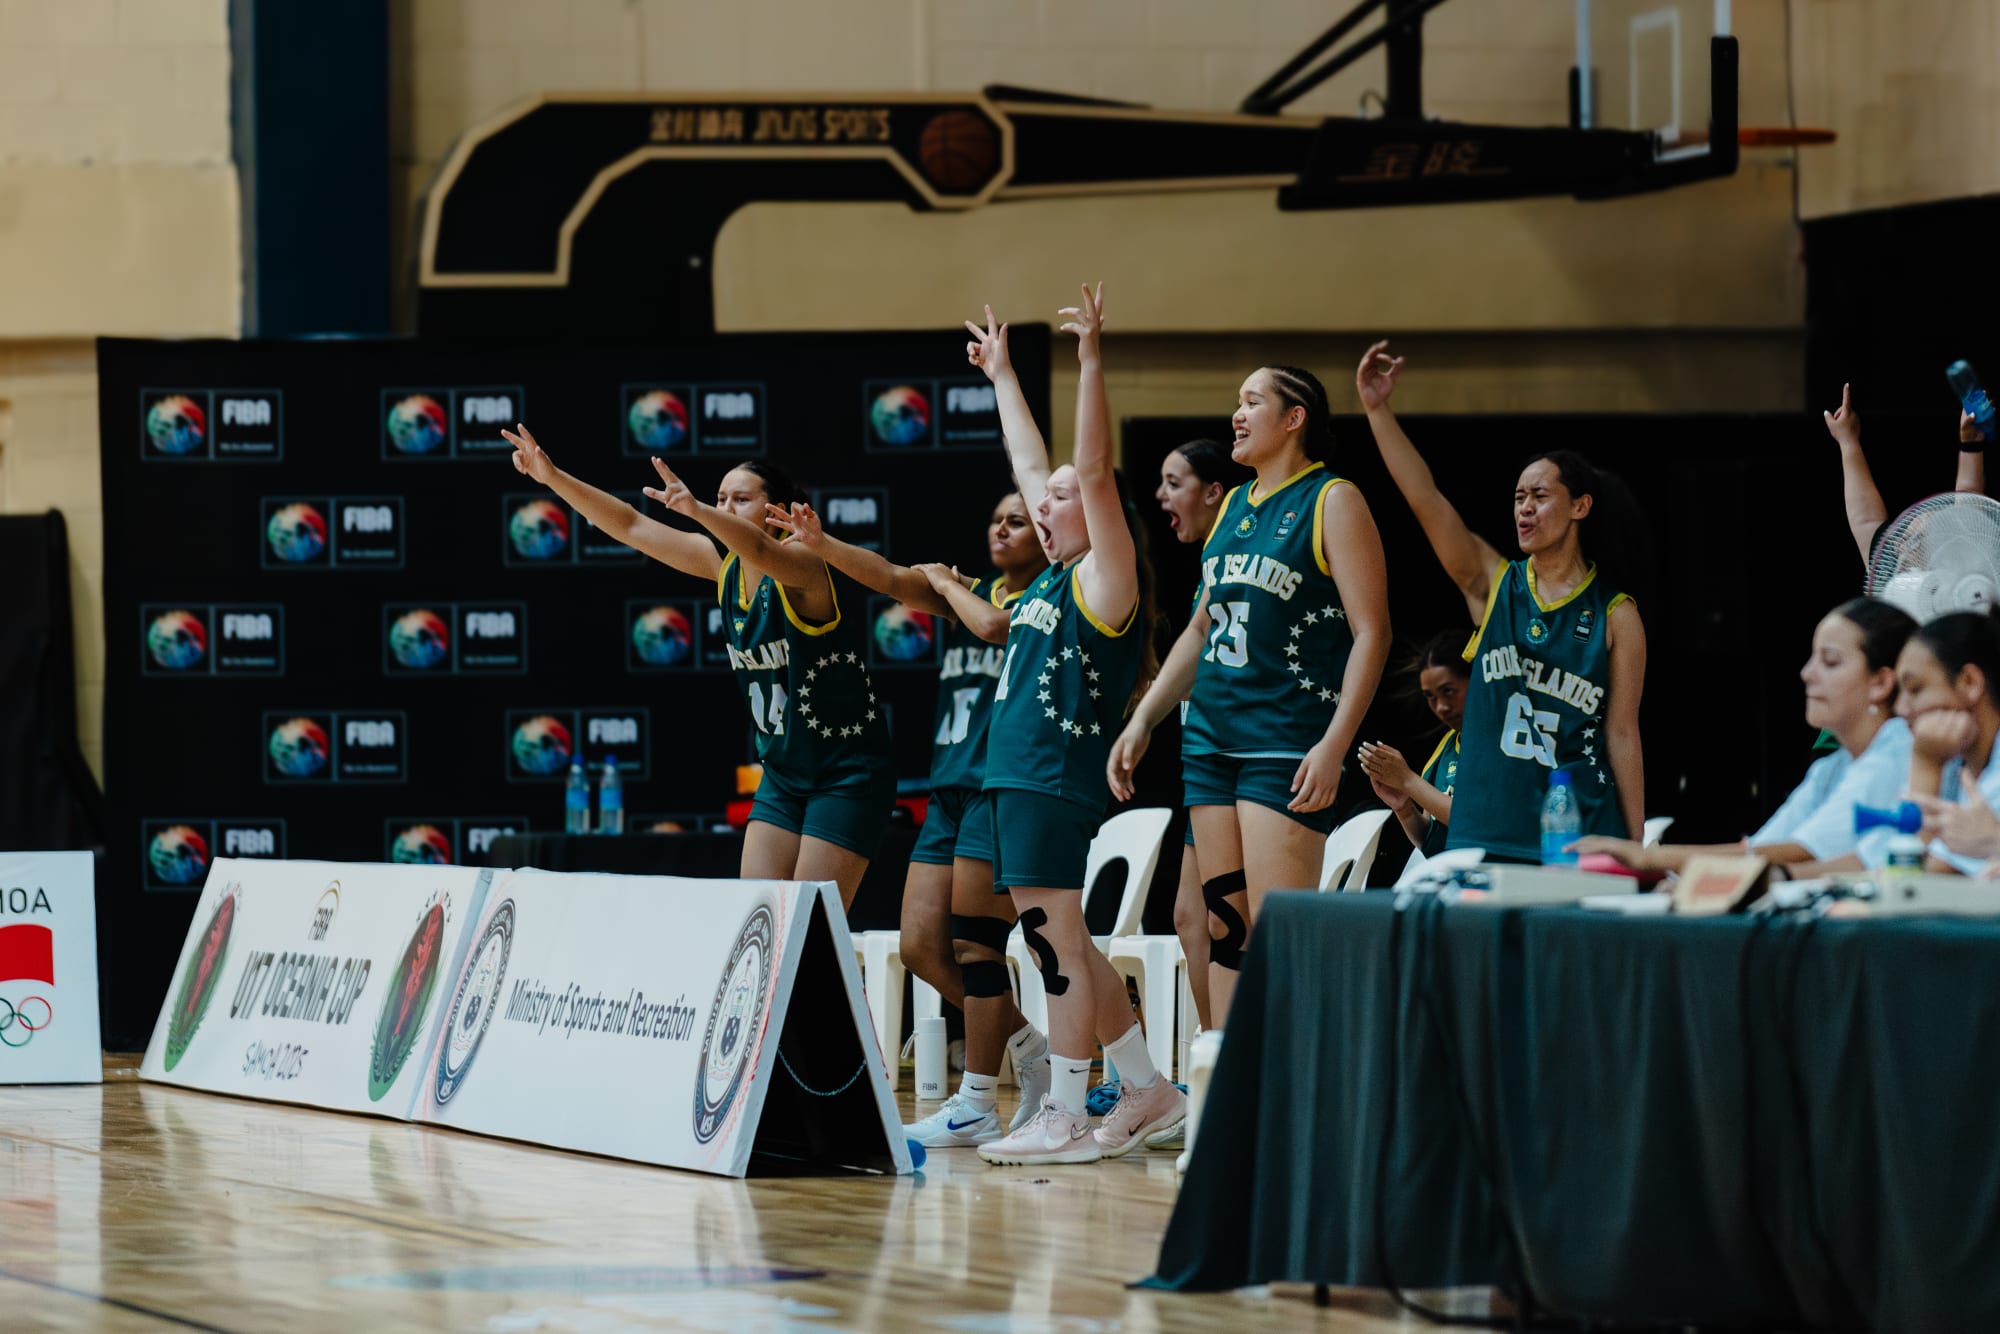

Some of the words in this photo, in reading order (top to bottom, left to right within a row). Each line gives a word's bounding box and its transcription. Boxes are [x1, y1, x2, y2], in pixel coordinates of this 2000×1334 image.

[222, 399, 271, 425] FIBA
[463, 397, 512, 423] FIBA
[705, 393, 754, 418] FIBA
[344, 506, 392, 532] FIBA
[827, 498, 877, 524] FIBA
[1220, 554, 1303, 601] ISLANDS
[223, 614, 272, 640] FIBA
[466, 612, 515, 638] FIBA
[1521, 657, 1604, 715] SLANDS
[346, 721, 394, 747] FIBA
[588, 718, 637, 744] FIBA
[1500, 691, 1560, 769] 65
[225, 829, 274, 854] FIBA
[0, 887, 52, 914] OA
[262, 951, 339, 1022] OCEANIA
[326, 956, 371, 1025] CUP
[504, 978, 556, 1036] Ministry
[551, 982, 574, 1027] of
[564, 985, 605, 1040] Sports
[602, 988, 634, 1034] and
[626, 991, 696, 1041] Recreation
[922, 1082, 938, 1091] FIBA
